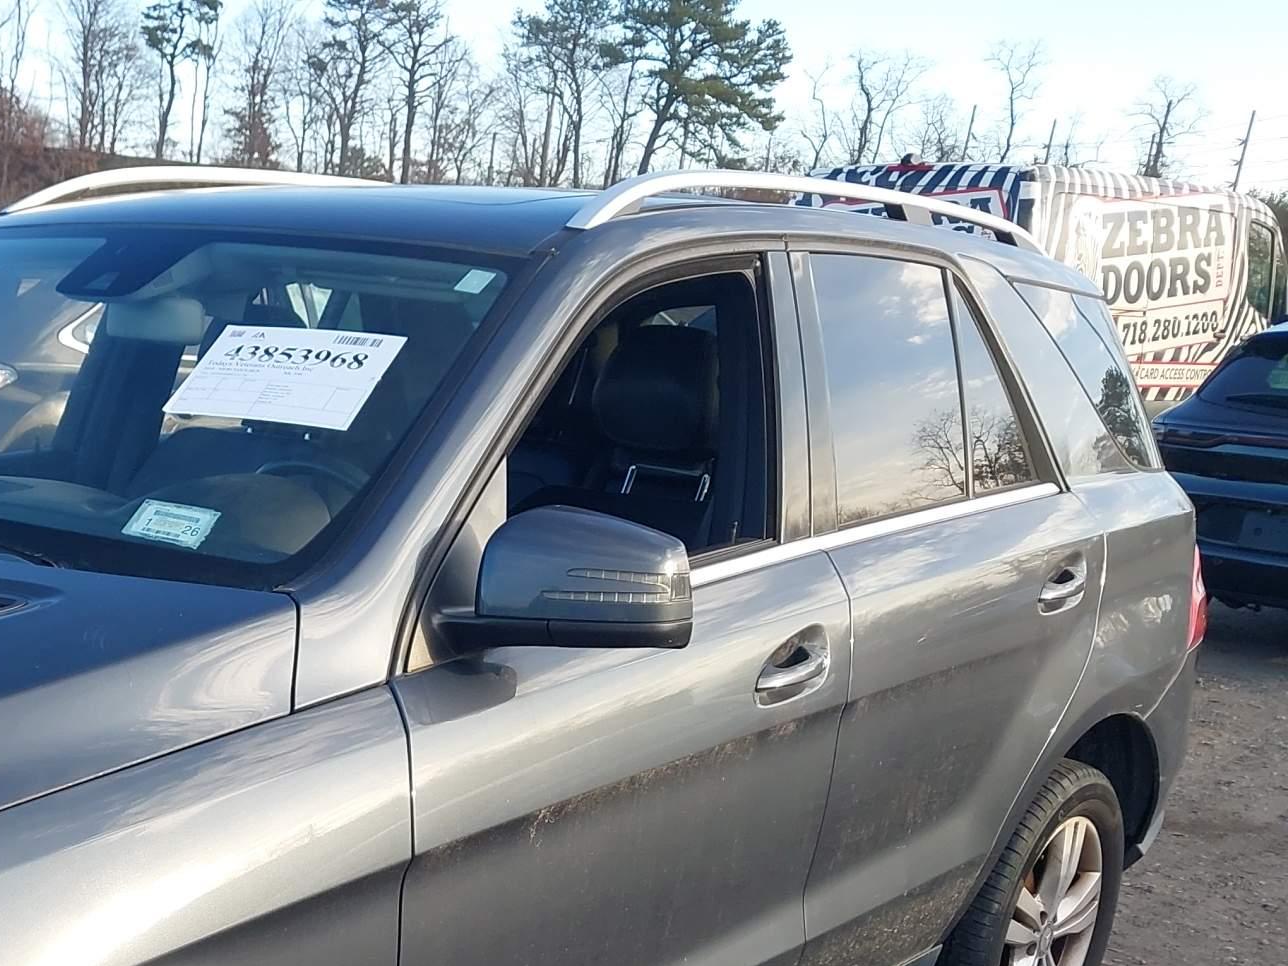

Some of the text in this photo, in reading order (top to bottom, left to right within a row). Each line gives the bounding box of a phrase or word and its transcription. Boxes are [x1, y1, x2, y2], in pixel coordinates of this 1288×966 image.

[1101, 204, 1225, 259] ZEBRA
[1101, 252, 1212, 306] DOORS
[1122, 310, 1219, 346] 718.280.1200
[224, 344, 369, 371] 43853968
[1139, 368, 1160, 380] CARD
[1160, 368, 1185, 380] ACCESS
[1185, 368, 1212, 380] CONTRO
[145, 518, 153, 527] 1
[181, 525, 201, 537] 26
